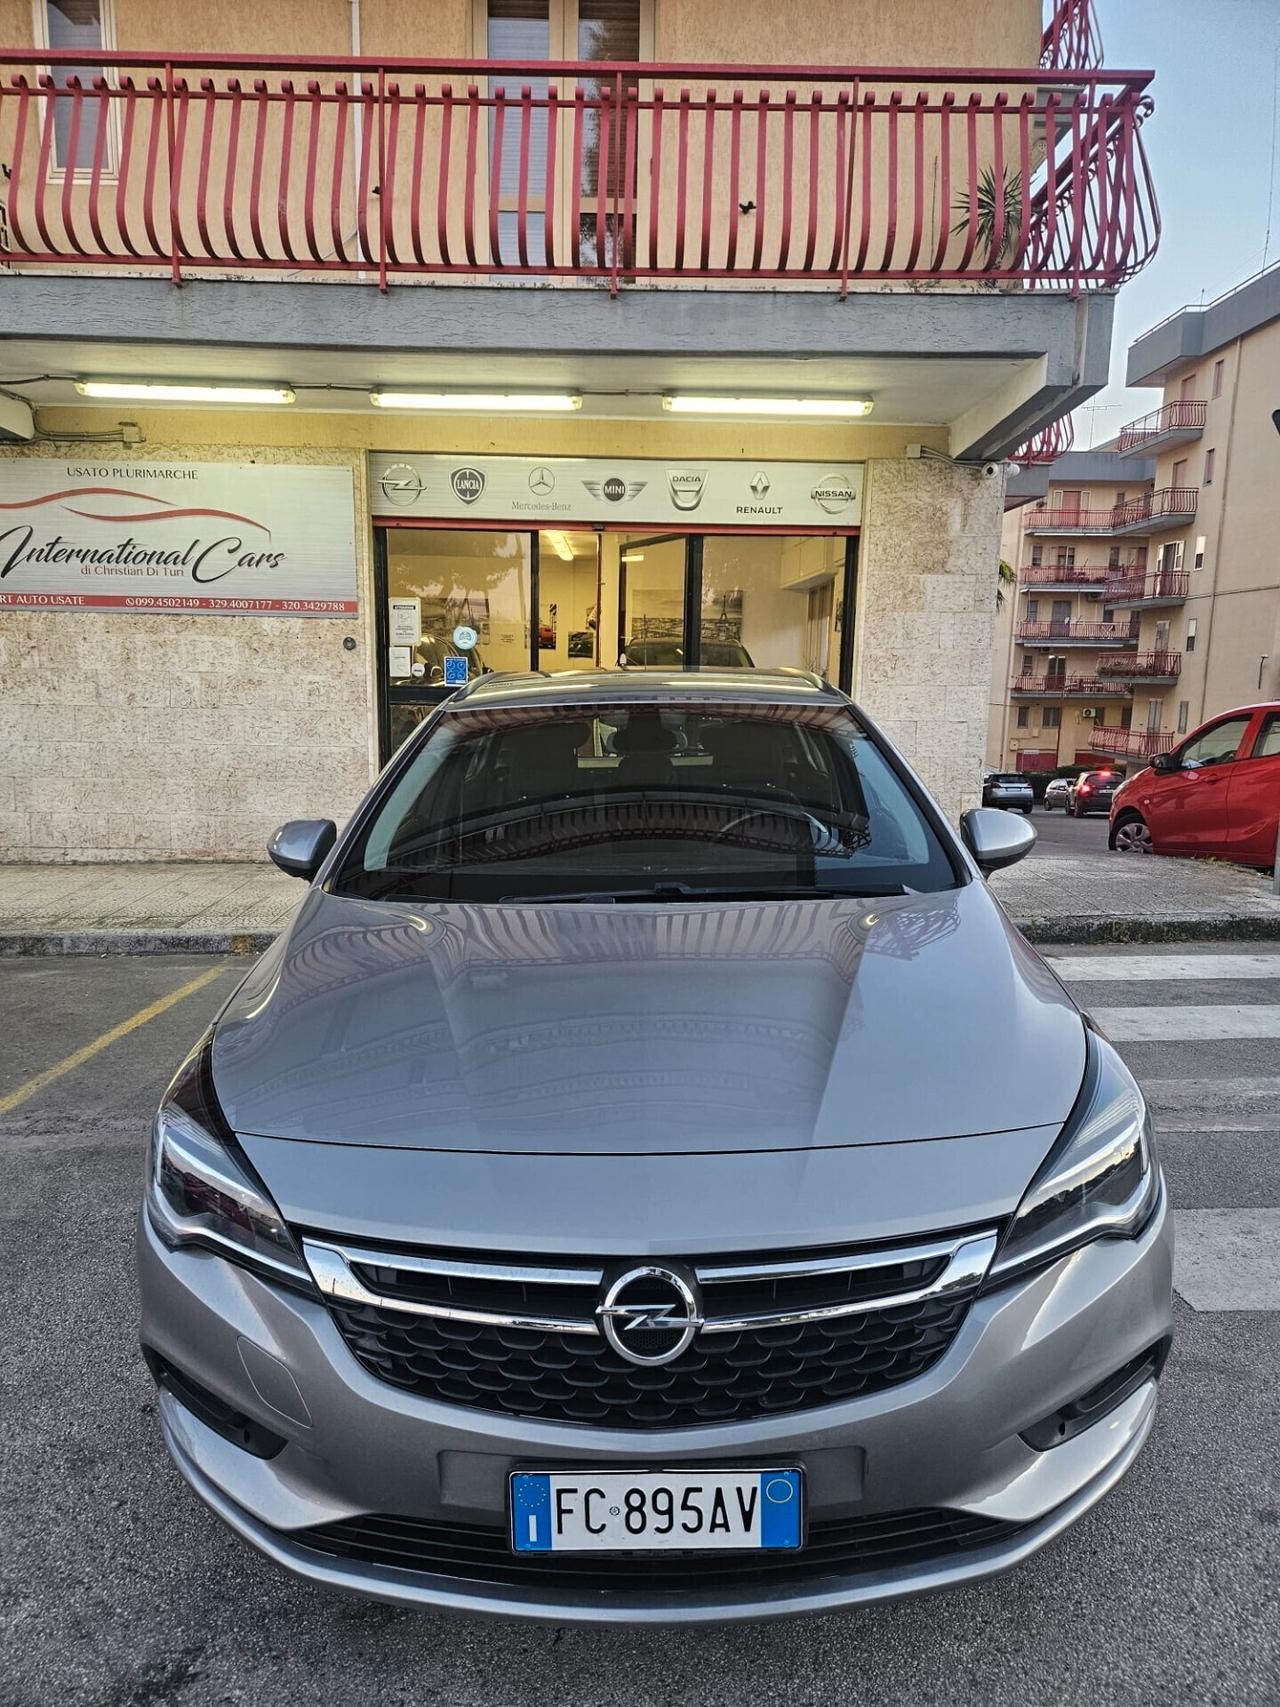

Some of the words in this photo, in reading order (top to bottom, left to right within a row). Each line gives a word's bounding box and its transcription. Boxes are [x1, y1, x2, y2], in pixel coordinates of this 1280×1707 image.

[67, 467, 109, 478] USATO
[112, 468, 199, 480] PLURIMARCHE
[672, 474, 702, 483] DACIA
[456, 478, 480, 491] LANCIA
[603, 484, 625, 495] MINI
[815, 489, 853, 498] NISSAN
[511, 501, 572, 512] Mercedes-Benz
[736, 506, 784, 515] RENAULT
[0, 525, 195, 579] International
[191, 536, 288, 584] Cars
[80, 565, 92, 575] di
[94, 565, 144, 576] Christian
[146, 566, 159, 576] Di
[162, 567, 184, 577] Turi
[16, 595, 48, 605] AUTO
[50, 596, 85, 606] USATE
[135, 597, 200, 609] 099.4502149
[208, 599, 273, 609] 329.4007177
[281, 601, 345, 611] 320.3429788
[555, 1487, 607, 1535] FC
[623, 1486, 758, 1535] 895AV
